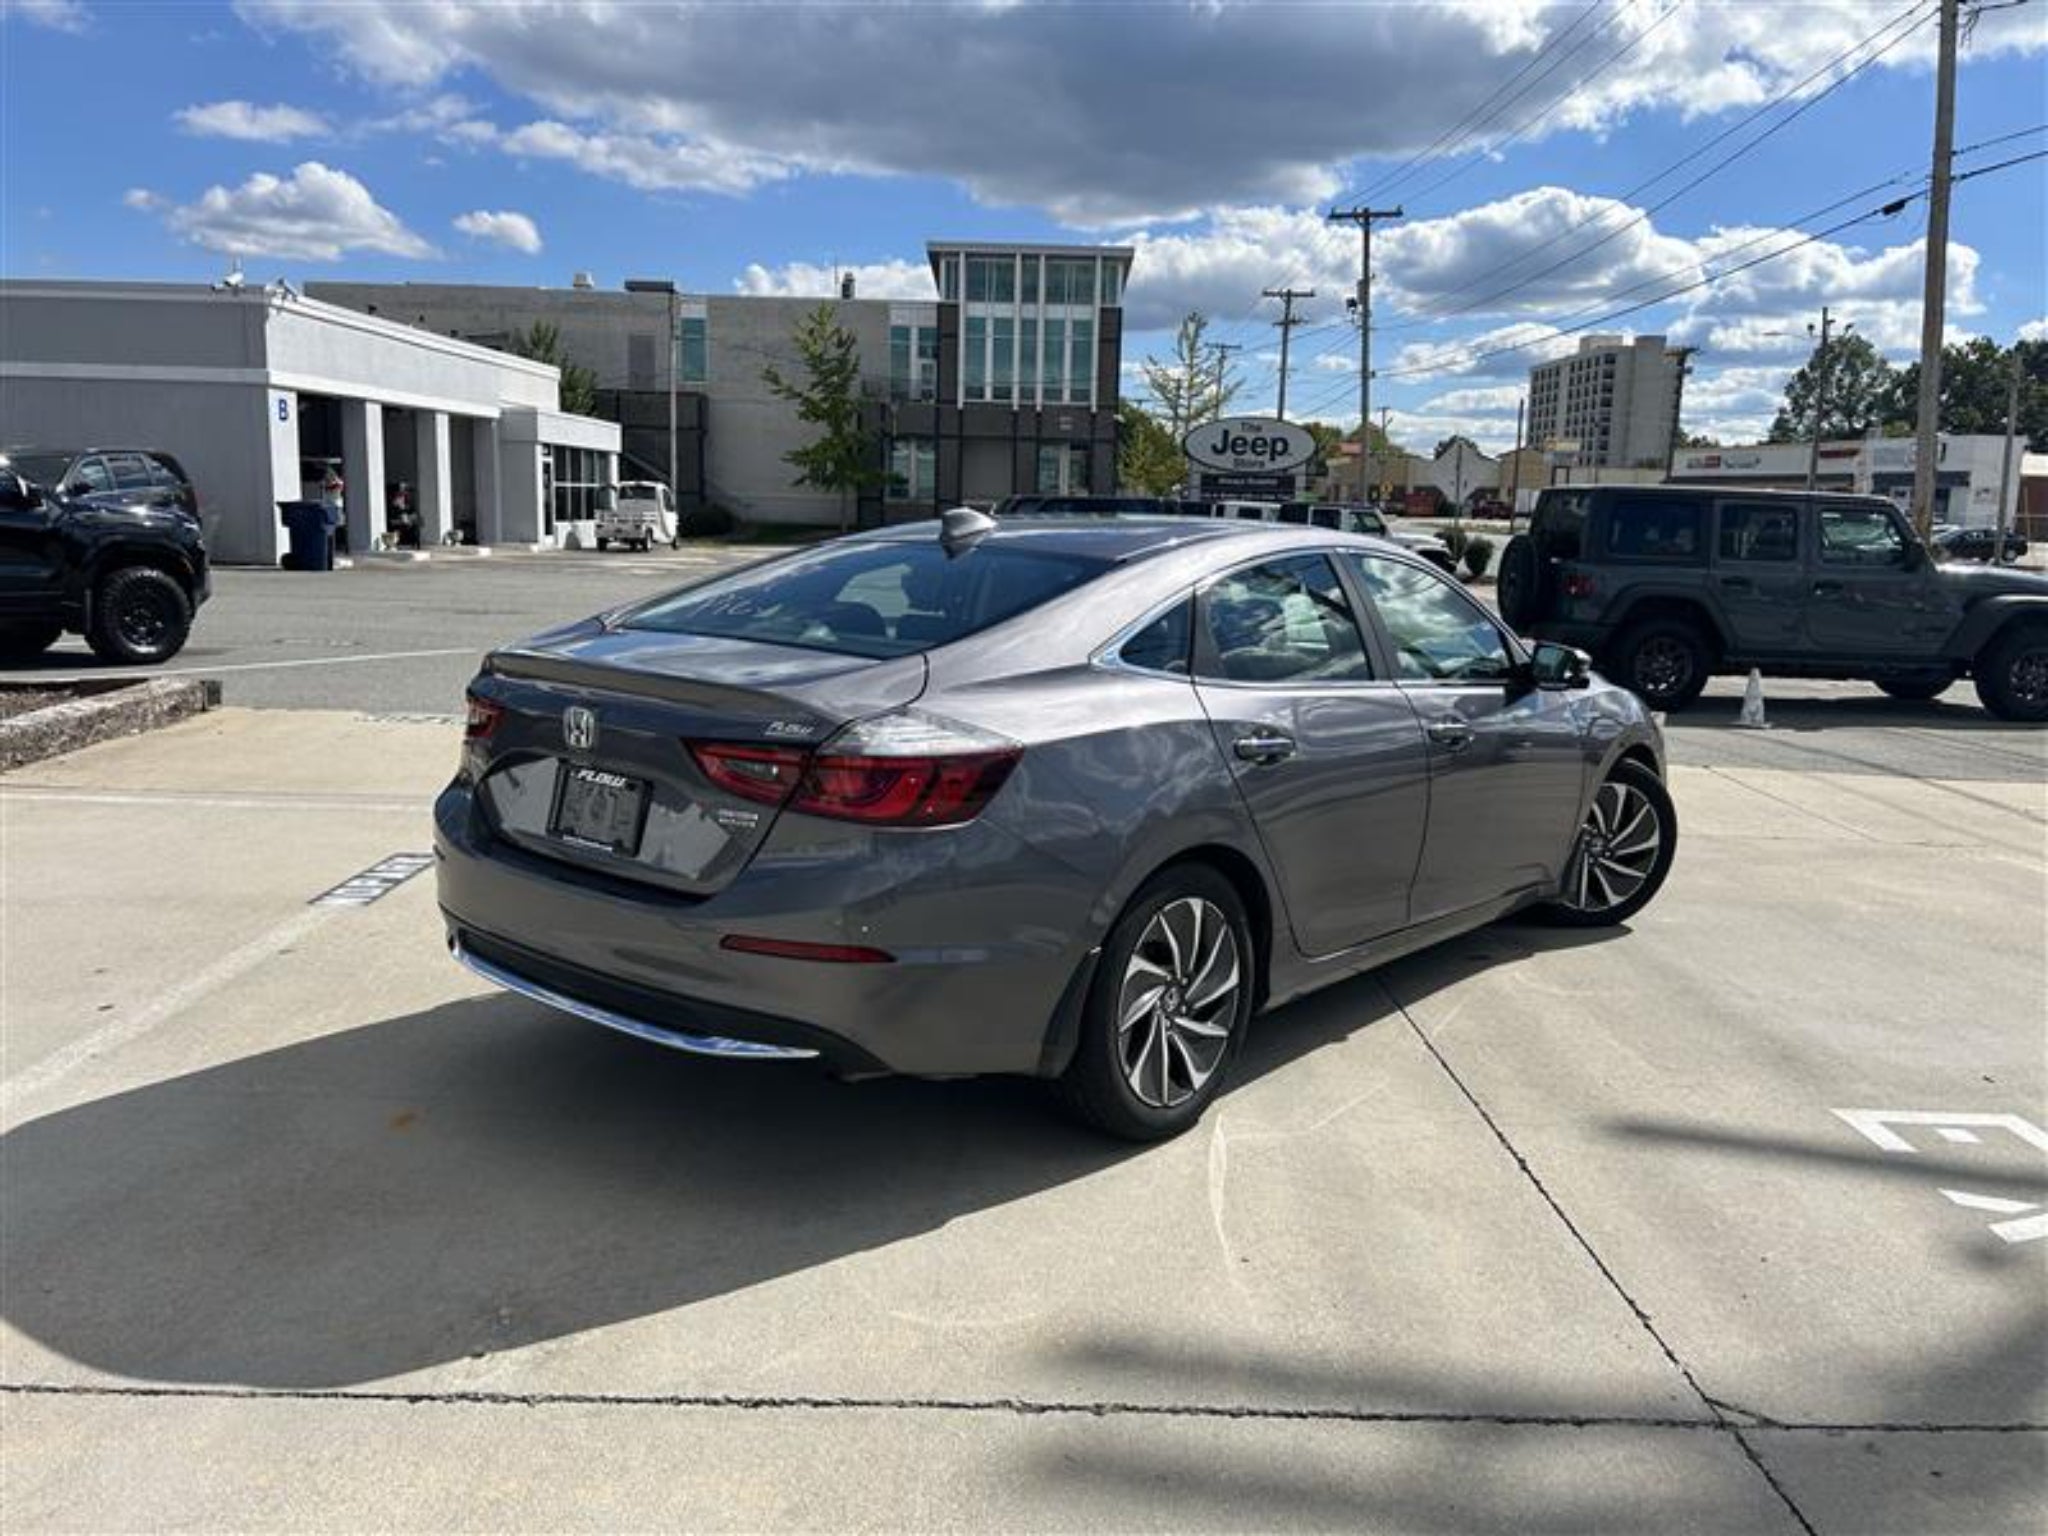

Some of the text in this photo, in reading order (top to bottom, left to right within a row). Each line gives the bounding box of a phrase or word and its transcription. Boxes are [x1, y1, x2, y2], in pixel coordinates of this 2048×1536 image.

[278, 399, 289, 420] B
[1241, 422, 1263, 432] The
[1210, 429, 1289, 462] Jeep
[576, 769, 627, 788] FLOW
